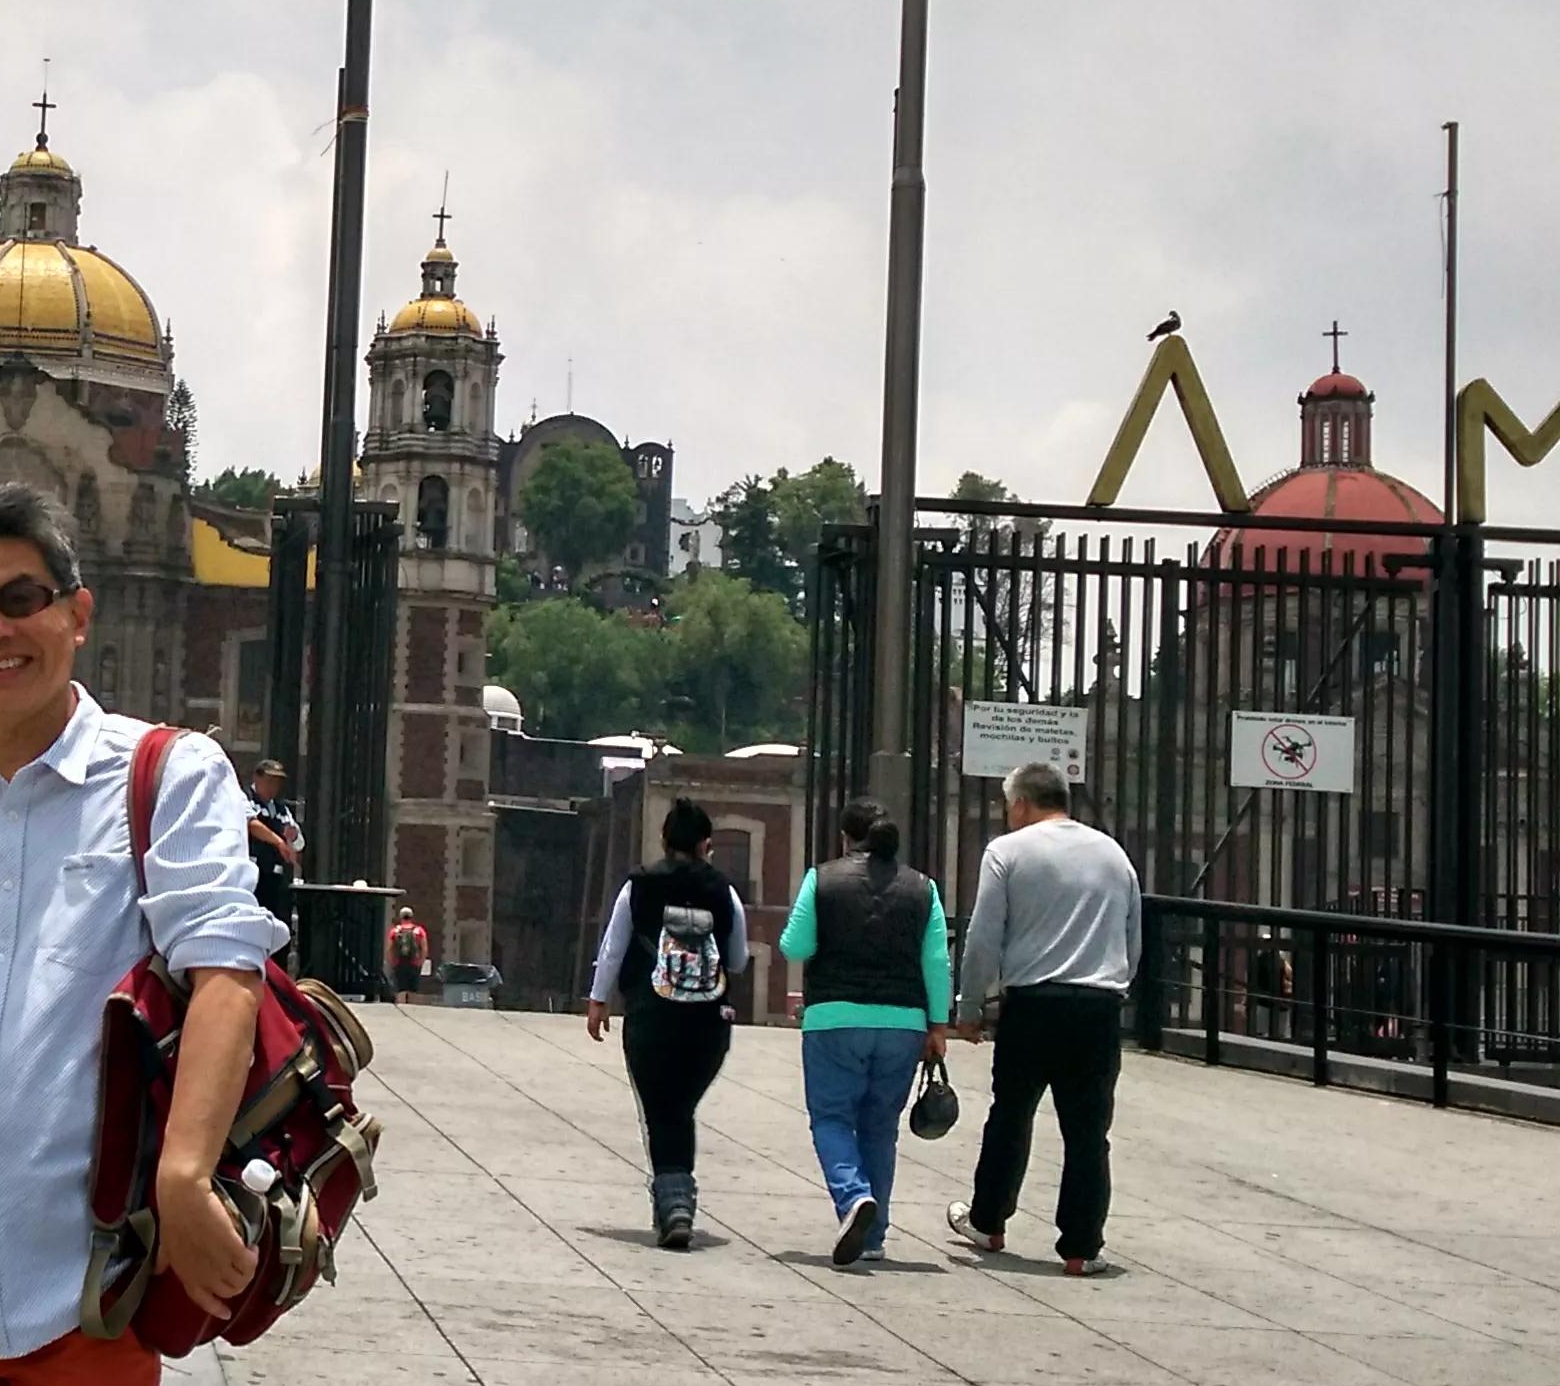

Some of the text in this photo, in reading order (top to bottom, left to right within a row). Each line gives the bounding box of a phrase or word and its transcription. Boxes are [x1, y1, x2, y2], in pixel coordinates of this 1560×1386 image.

[973, 704, 990, 712] Por
[1007, 708, 1058, 717] seguridad
[1025, 717, 1058, 725] demás
[972, 722, 1017, 732] Revisión
[1020, 725, 1032, 733] de
[979, 733, 1025, 742] mochilas
[1038, 736, 1069, 745] bultos
